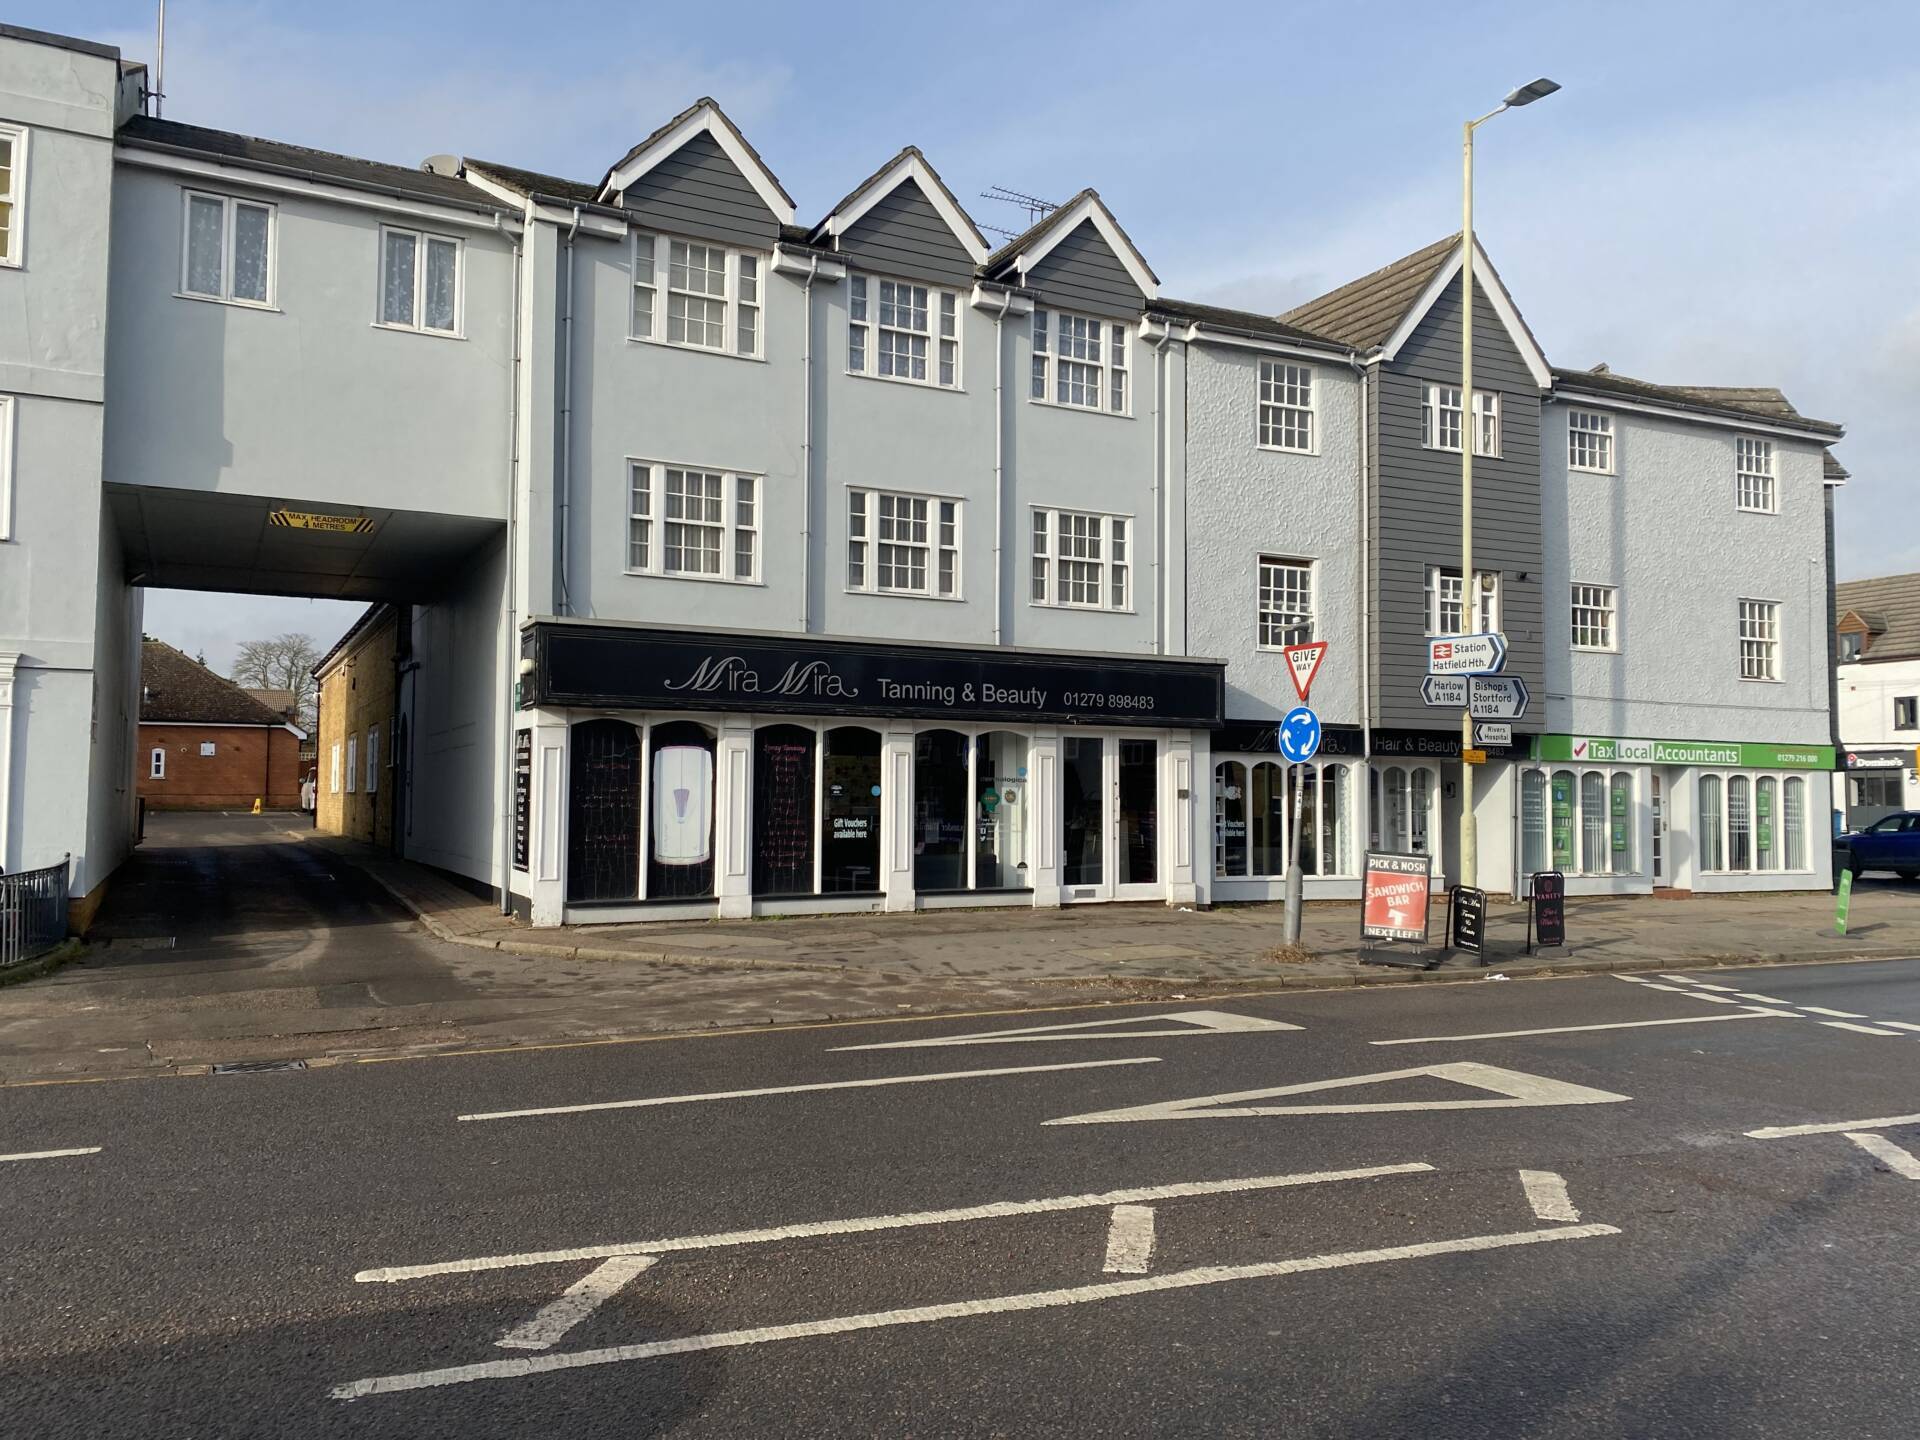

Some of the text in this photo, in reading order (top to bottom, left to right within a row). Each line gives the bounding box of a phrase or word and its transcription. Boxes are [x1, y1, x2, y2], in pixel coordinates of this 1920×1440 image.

[311, 516, 357, 525] HEADROOM
[312, 522, 346, 530] METRES
[1454, 643, 1487, 654] Station
[1292, 649, 1317, 663] GIVE
[1296, 662, 1312, 671] WAY
[1433, 658, 1487, 670] Hatfield Hth.
[664, 656, 1155, 710] Mira Mira Tanning & Beauty 01279 898483
[1434, 681, 1464, 691] Harlow
[1475, 681, 1508, 692] Bishop's
[1473, 693, 1512, 703] Stortford
[1484, 733, 1509, 742] Hospital
[1375, 736, 1401, 750] Hair
[1404, 738, 1413, 751] &
[1418, 737, 1461, 756] Beauty
[1590, 742, 1614, 758] Tax
[1617, 743, 1652, 759] Local
[1655, 745, 1738, 763] Accountants
[1856, 757, 1905, 767] Domino's
[833, 817, 868, 828] Gift Vouchers
[833, 829, 868, 839] available here
[1369, 859, 1426, 872] PICK & NOSH
[1367, 881, 1424, 898] SANDWICH
[1386, 895, 1410, 907] BAR
[1368, 927, 1420, 939] NEXT LEFT
